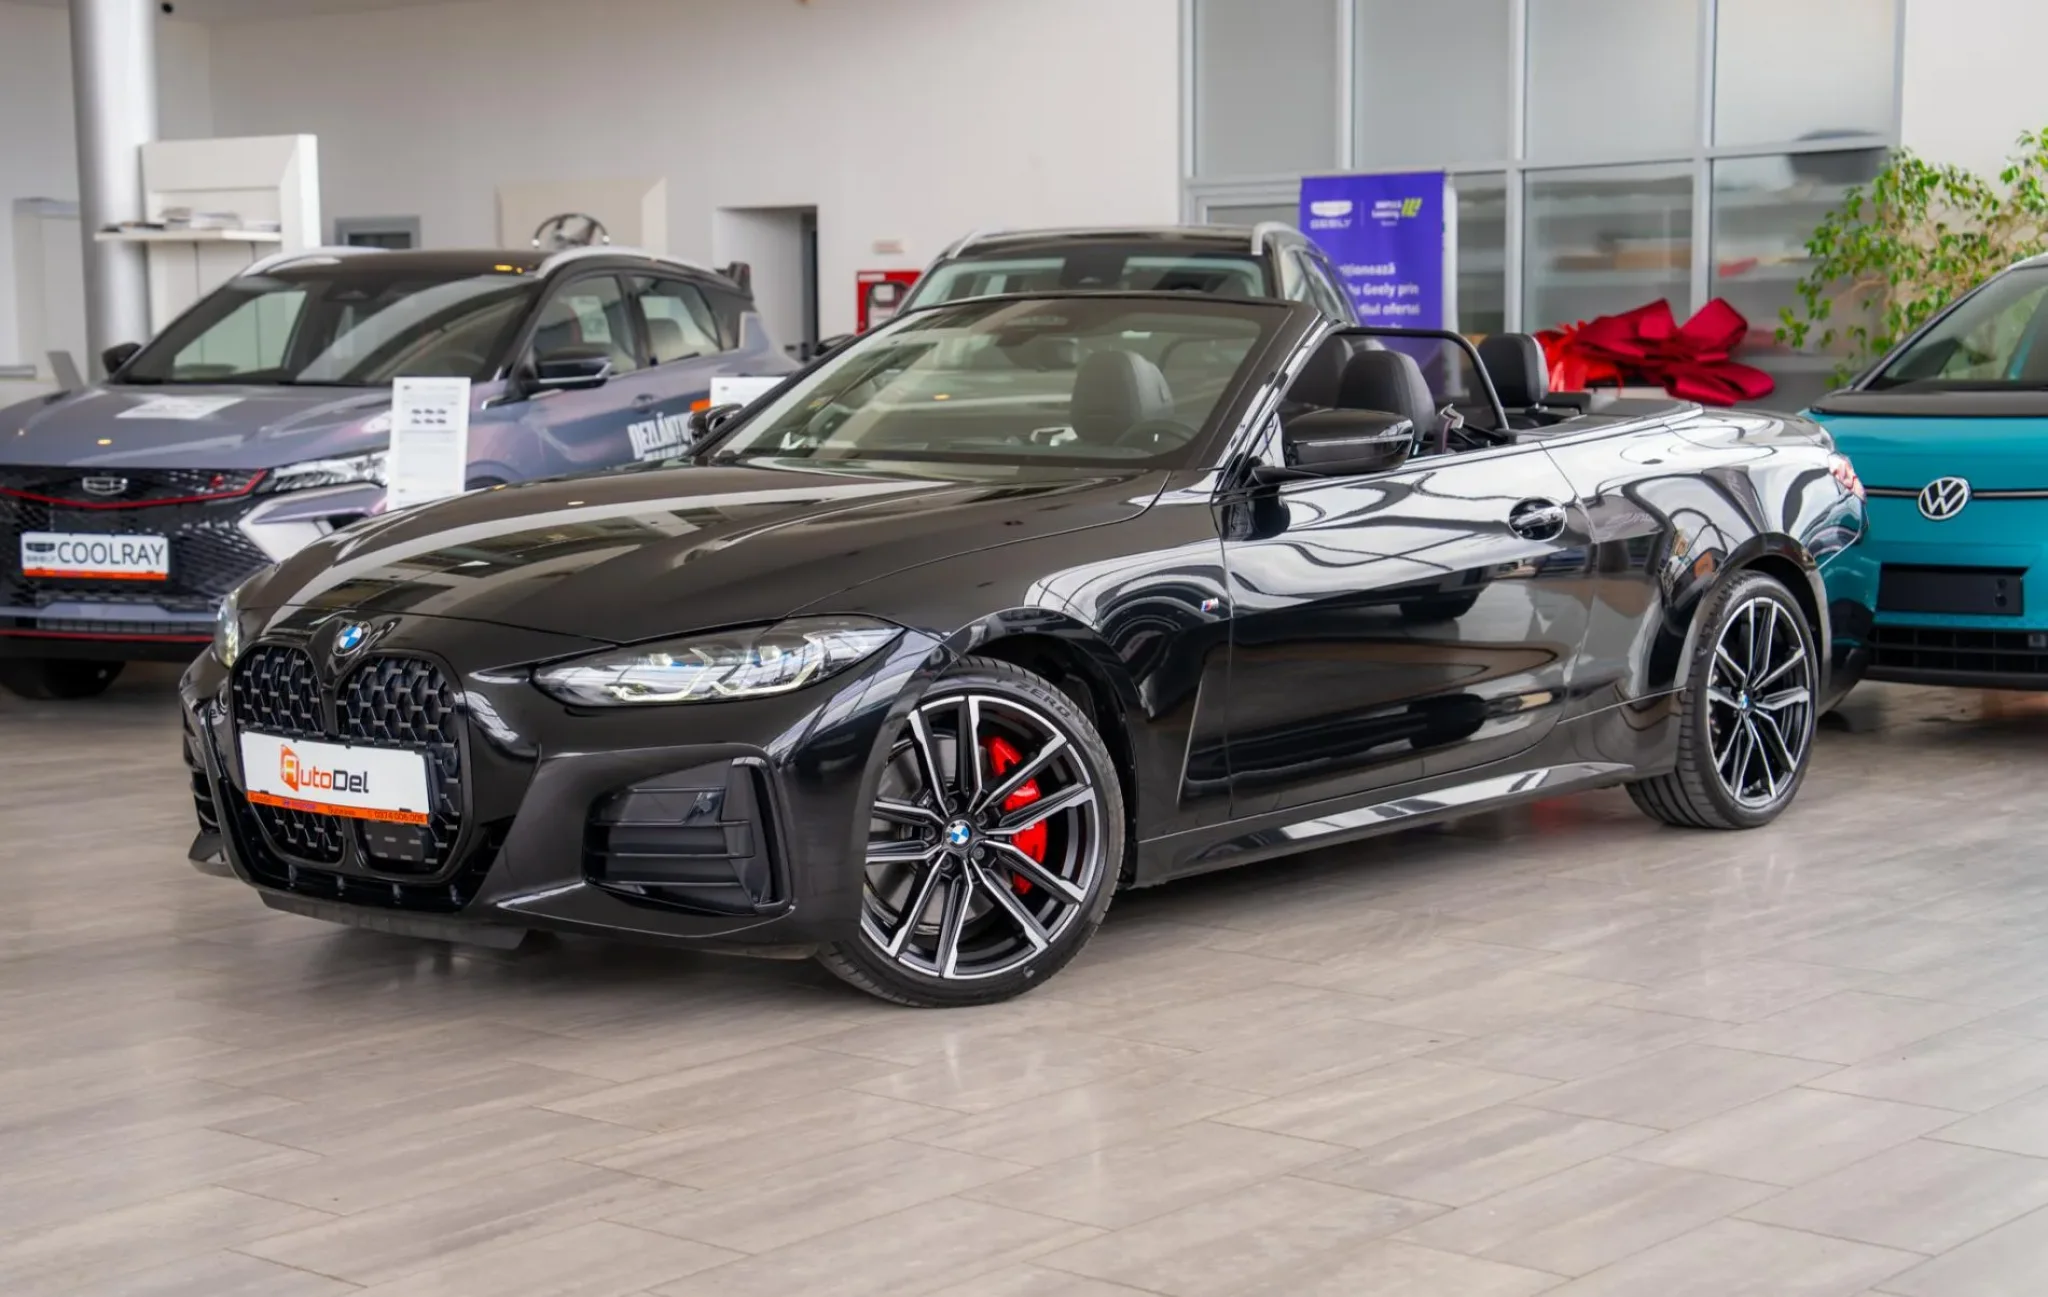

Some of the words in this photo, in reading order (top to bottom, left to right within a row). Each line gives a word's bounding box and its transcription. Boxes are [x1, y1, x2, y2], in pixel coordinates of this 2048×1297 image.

[1362, 282, 1396, 299] Geely
[57, 541, 164, 565] COOLRAY
[281, 744, 369, 793] AutoDel
